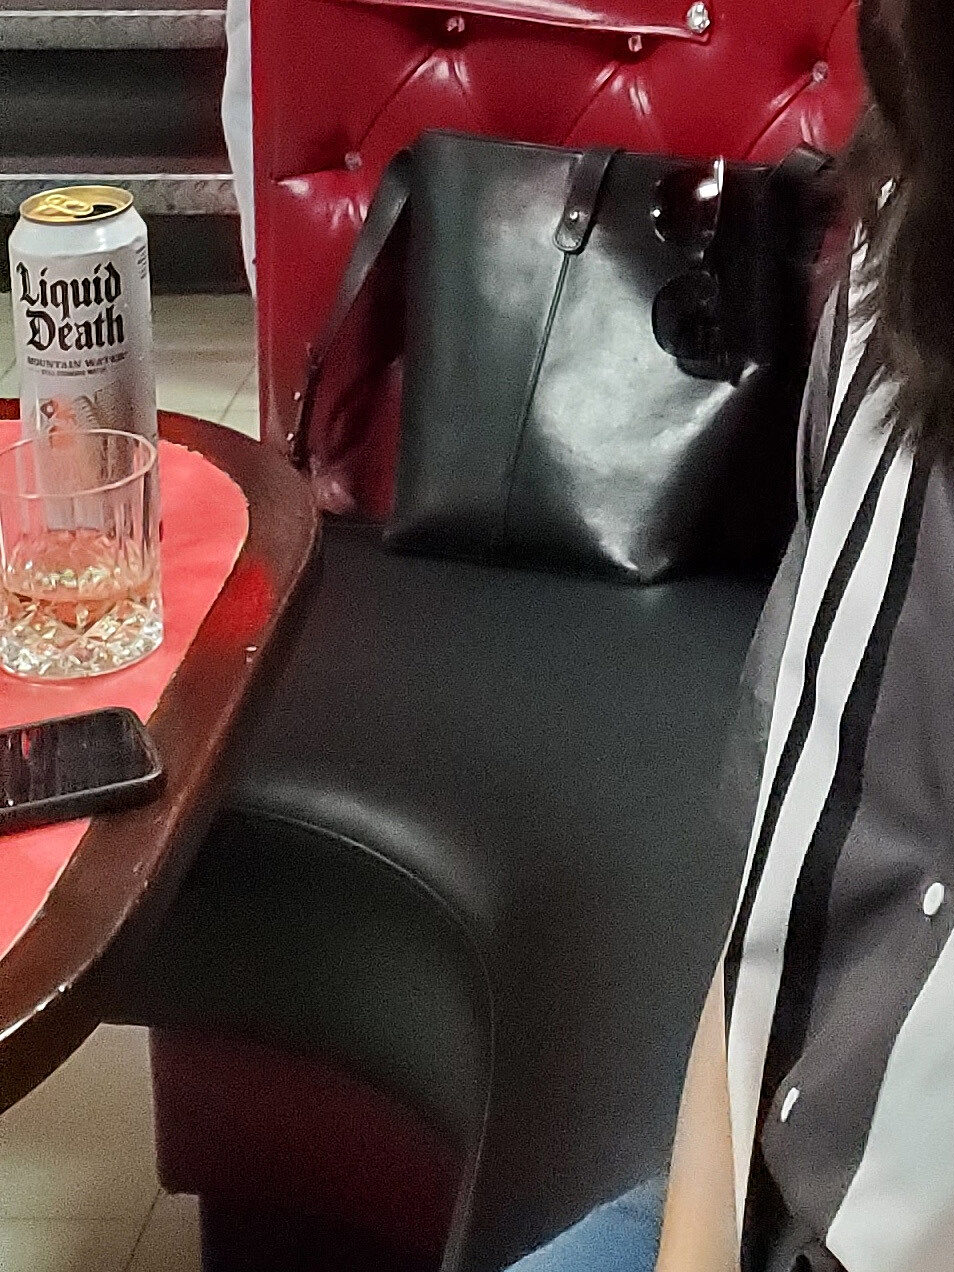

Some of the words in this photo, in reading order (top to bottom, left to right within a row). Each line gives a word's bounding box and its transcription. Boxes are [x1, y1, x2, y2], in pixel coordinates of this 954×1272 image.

[16, 261, 122, 320] Liquid
[26, 305, 125, 351] Death
[27, 356, 81, 369] MOUNTAIN
